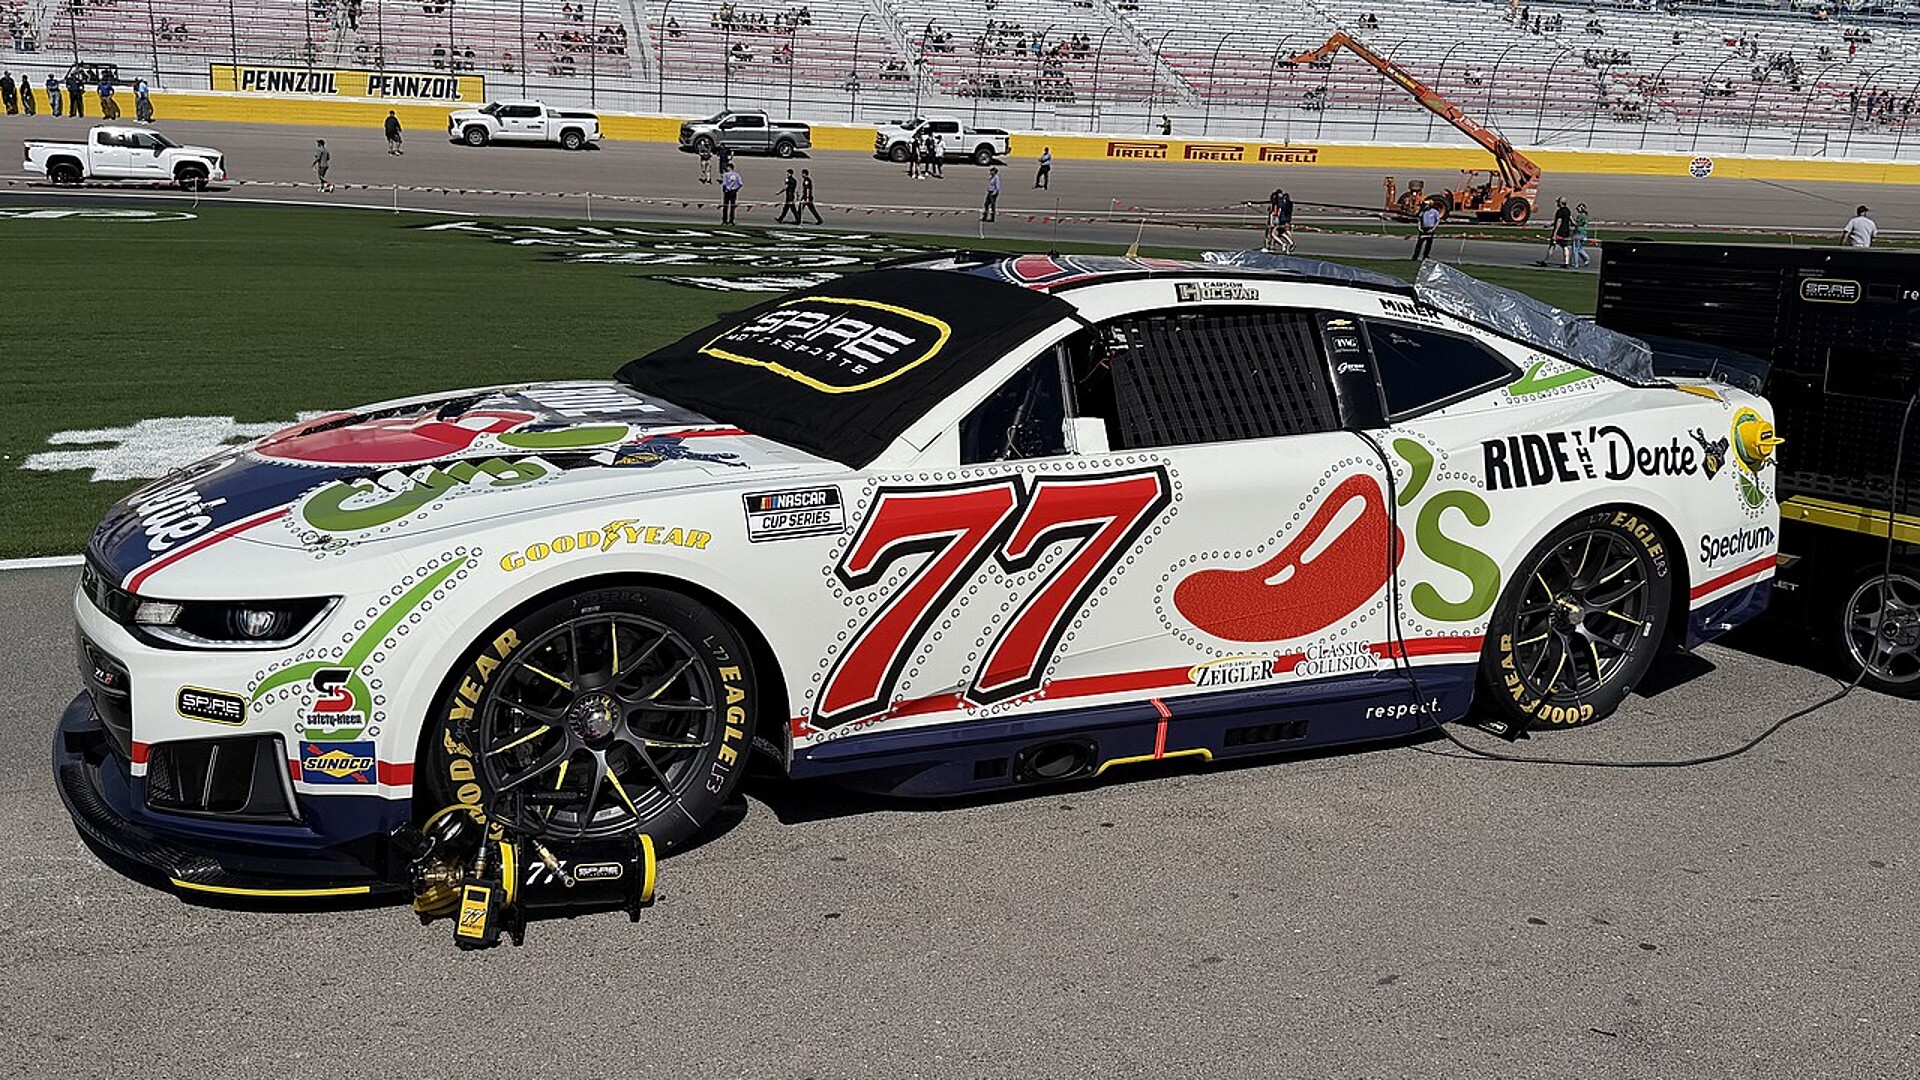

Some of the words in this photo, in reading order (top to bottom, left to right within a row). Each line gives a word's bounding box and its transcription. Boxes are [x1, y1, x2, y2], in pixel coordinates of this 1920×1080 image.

[242, 70, 338, 94] PENNZOIL
[367, 75, 461, 99] PENNZOIL
[1107, 142, 1168, 159] PIRELLI
[1184, 145, 1244, 161] PIRELLI
[1259, 147, 1319, 163] PIRELLI
[1378, 298, 1441, 320] MINER
[742, 309, 916, 364] SPIRE
[1481, 432, 1580, 491] RIDE
[778, 491, 827, 509] NASCAR
[762, 514, 788, 529] CUP
[788, 511, 831, 527] SERIES
[1610, 511, 1664, 558] EAGLE
[1700, 526, 1770, 568] Spectrum
[809, 465, 1172, 730] 77
[1307, 640, 1371, 660] CLASSIC
[1196, 659, 1273, 687] ZEIGLER
[1295, 654, 1376, 677] COLLISION
[182, 694, 241, 714] SPIRE
[718, 665, 746, 767] EAGLE
[306, 759, 371, 769] SUNOCO
